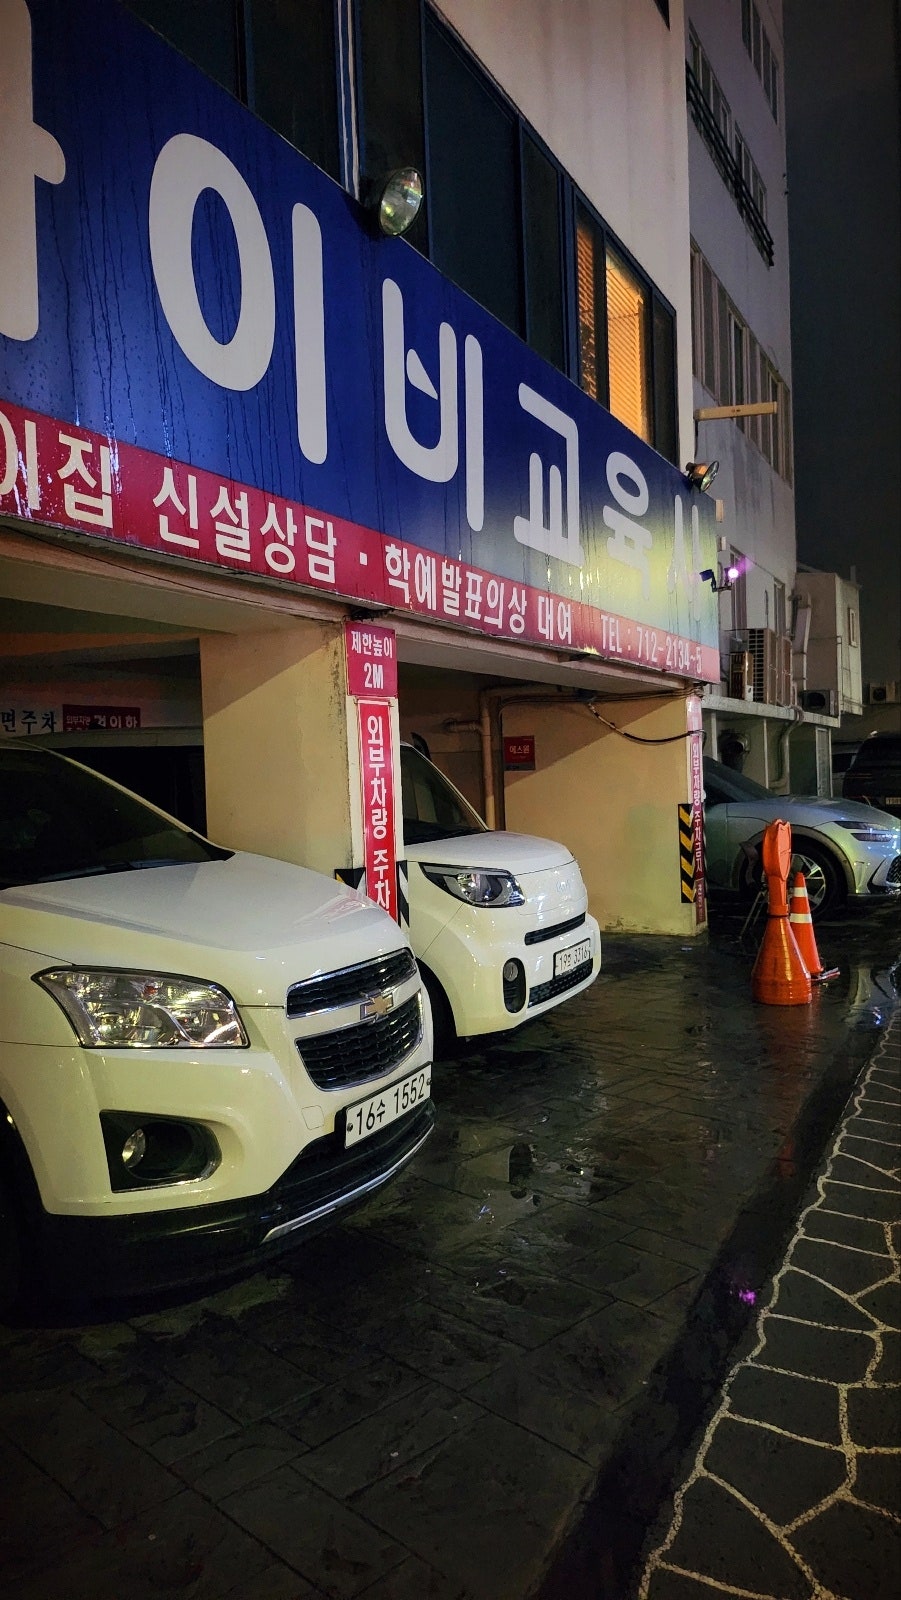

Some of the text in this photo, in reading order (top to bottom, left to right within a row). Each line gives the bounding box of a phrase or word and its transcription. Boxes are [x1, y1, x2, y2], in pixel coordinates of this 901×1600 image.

[0, 0, 706, 623] 이비교육사
[153, 467, 337, 584] 신설상담
[385, 543, 528, 634] 학예발표의상
[537, 595, 573, 645] 대여
[600, 614, 623, 653] TEL
[635, 625, 702, 674] 712-2134~5
[350, 629, 393, 659] 제한높이
[363, 662, 384, 690] 2M
[366, 715, 391, 914] 외부차량 주차
[356, 1072, 425, 1136] 16수 1552
